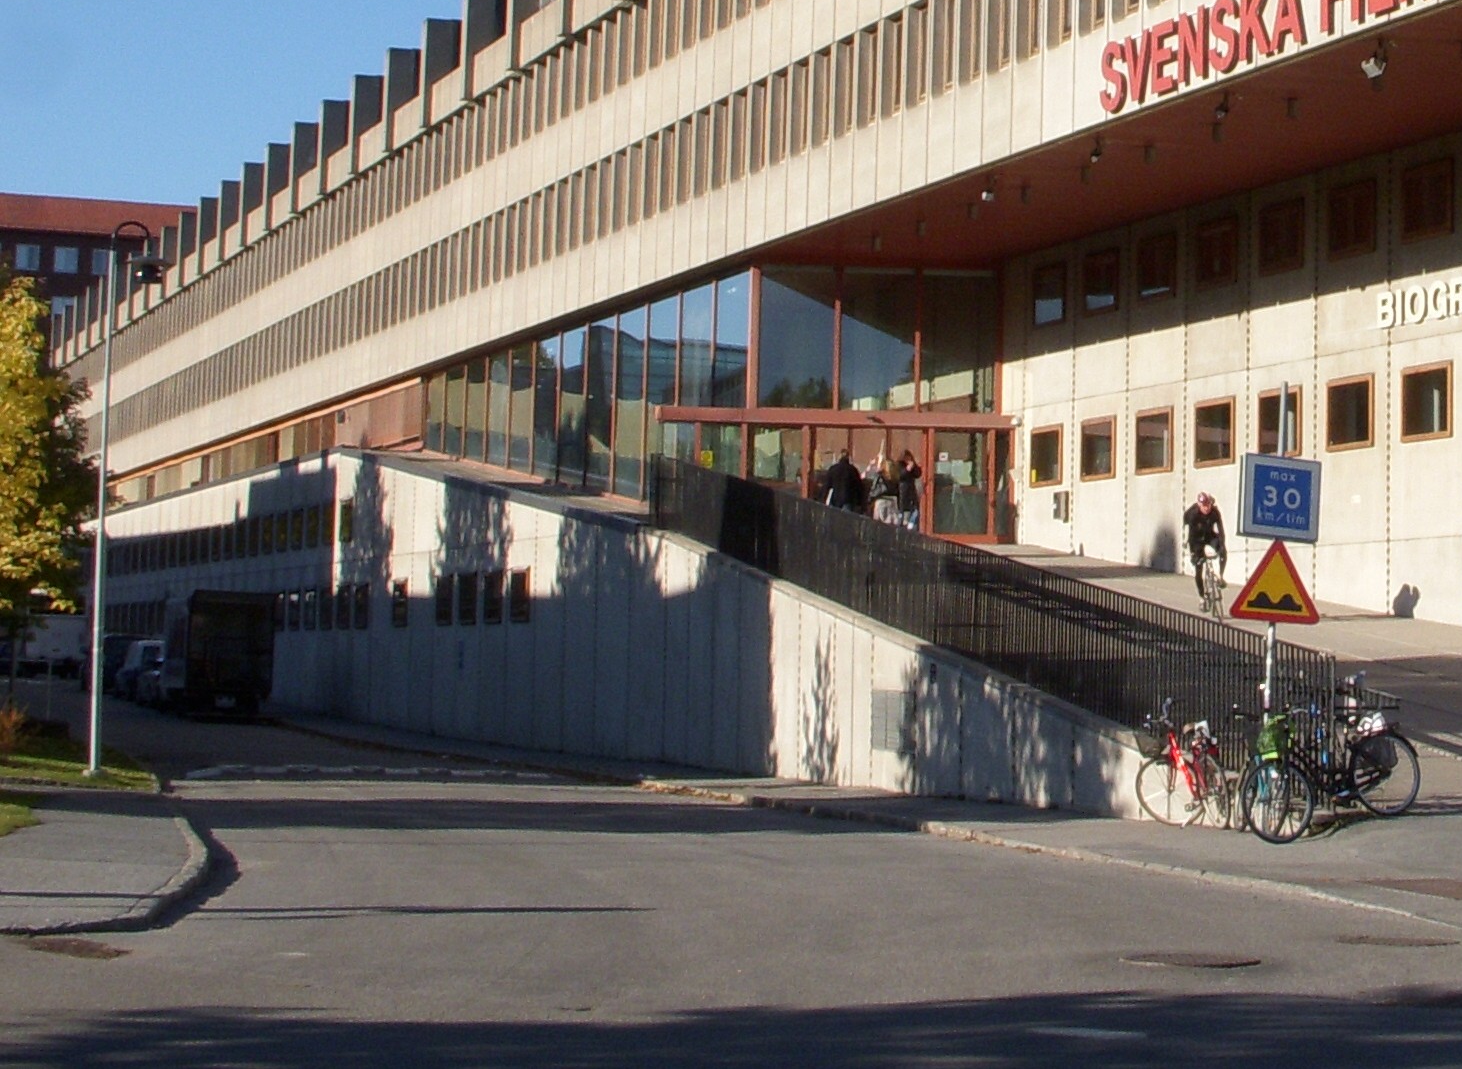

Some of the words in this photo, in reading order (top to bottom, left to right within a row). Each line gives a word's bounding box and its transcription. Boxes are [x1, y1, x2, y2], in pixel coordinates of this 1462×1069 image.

[1270, 471, 1296, 482] max
[1263, 485, 1301, 509] 30
[1256, 504, 1306, 524] km/tim
